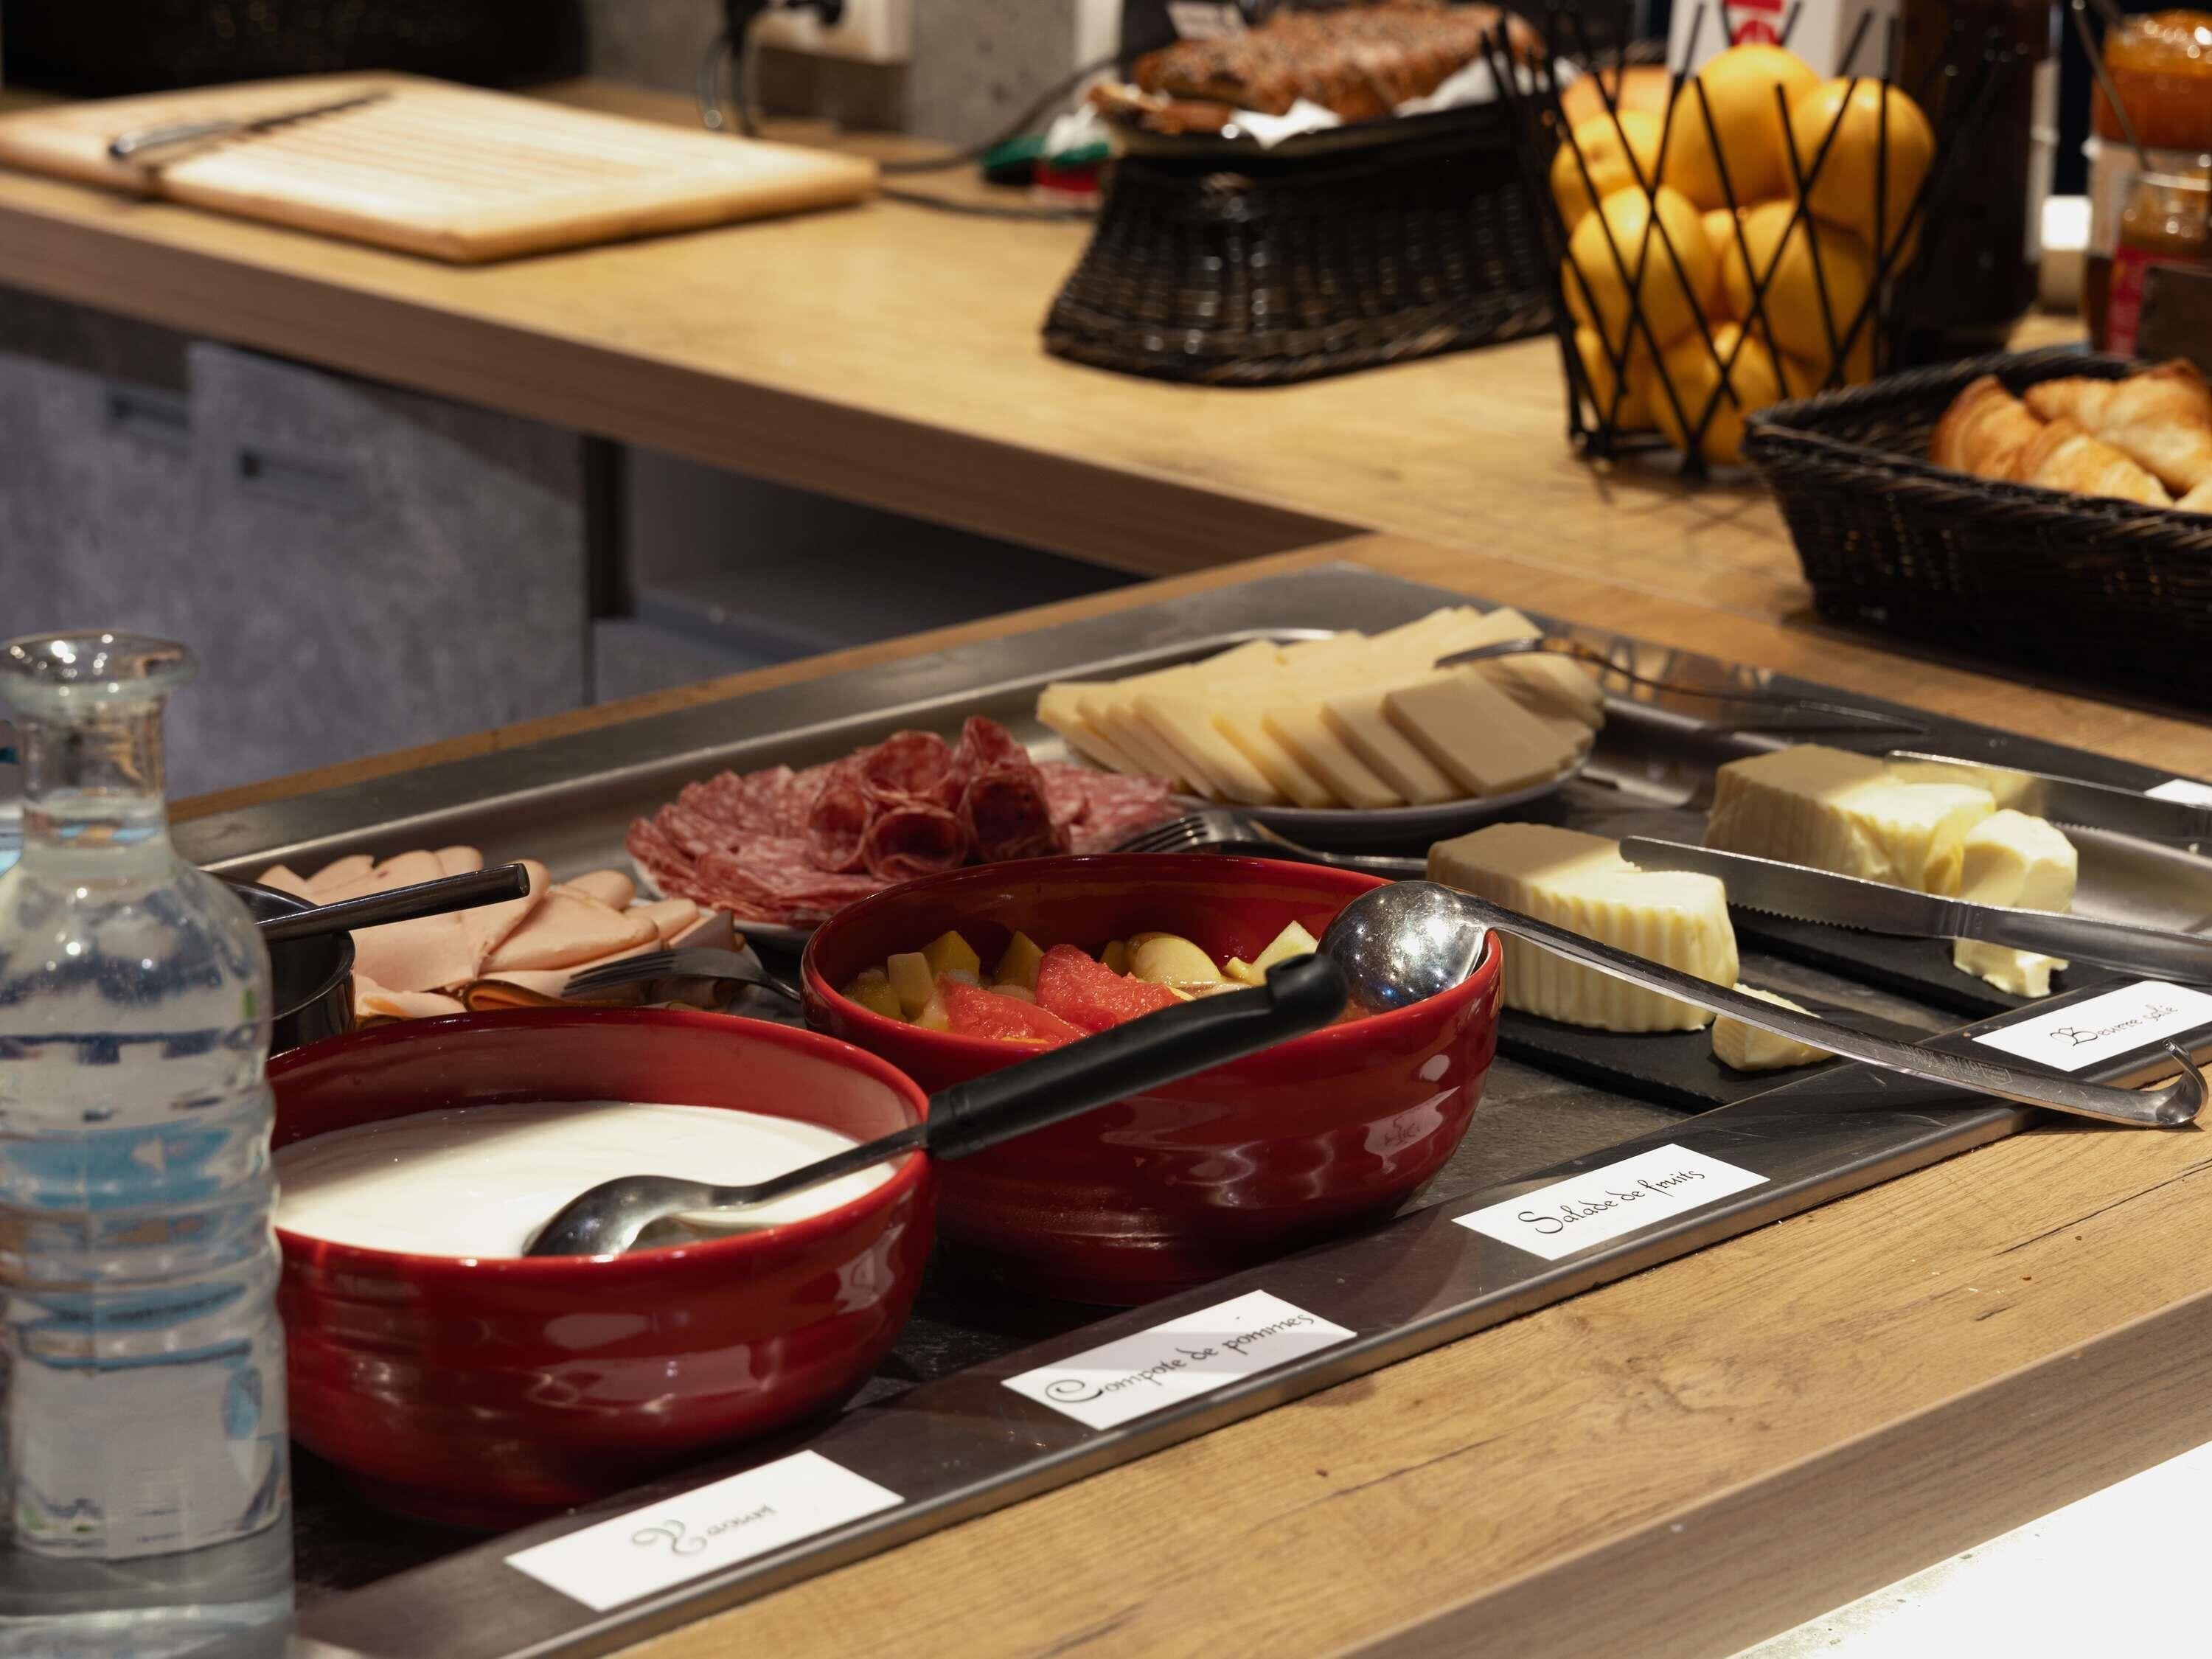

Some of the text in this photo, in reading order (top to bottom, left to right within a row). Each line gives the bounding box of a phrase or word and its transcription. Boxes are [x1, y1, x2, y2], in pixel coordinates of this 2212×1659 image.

[1517, 1168, 1705, 1234] Salade de fruits
[1045, 1312, 1315, 1402] Compote de pommes
